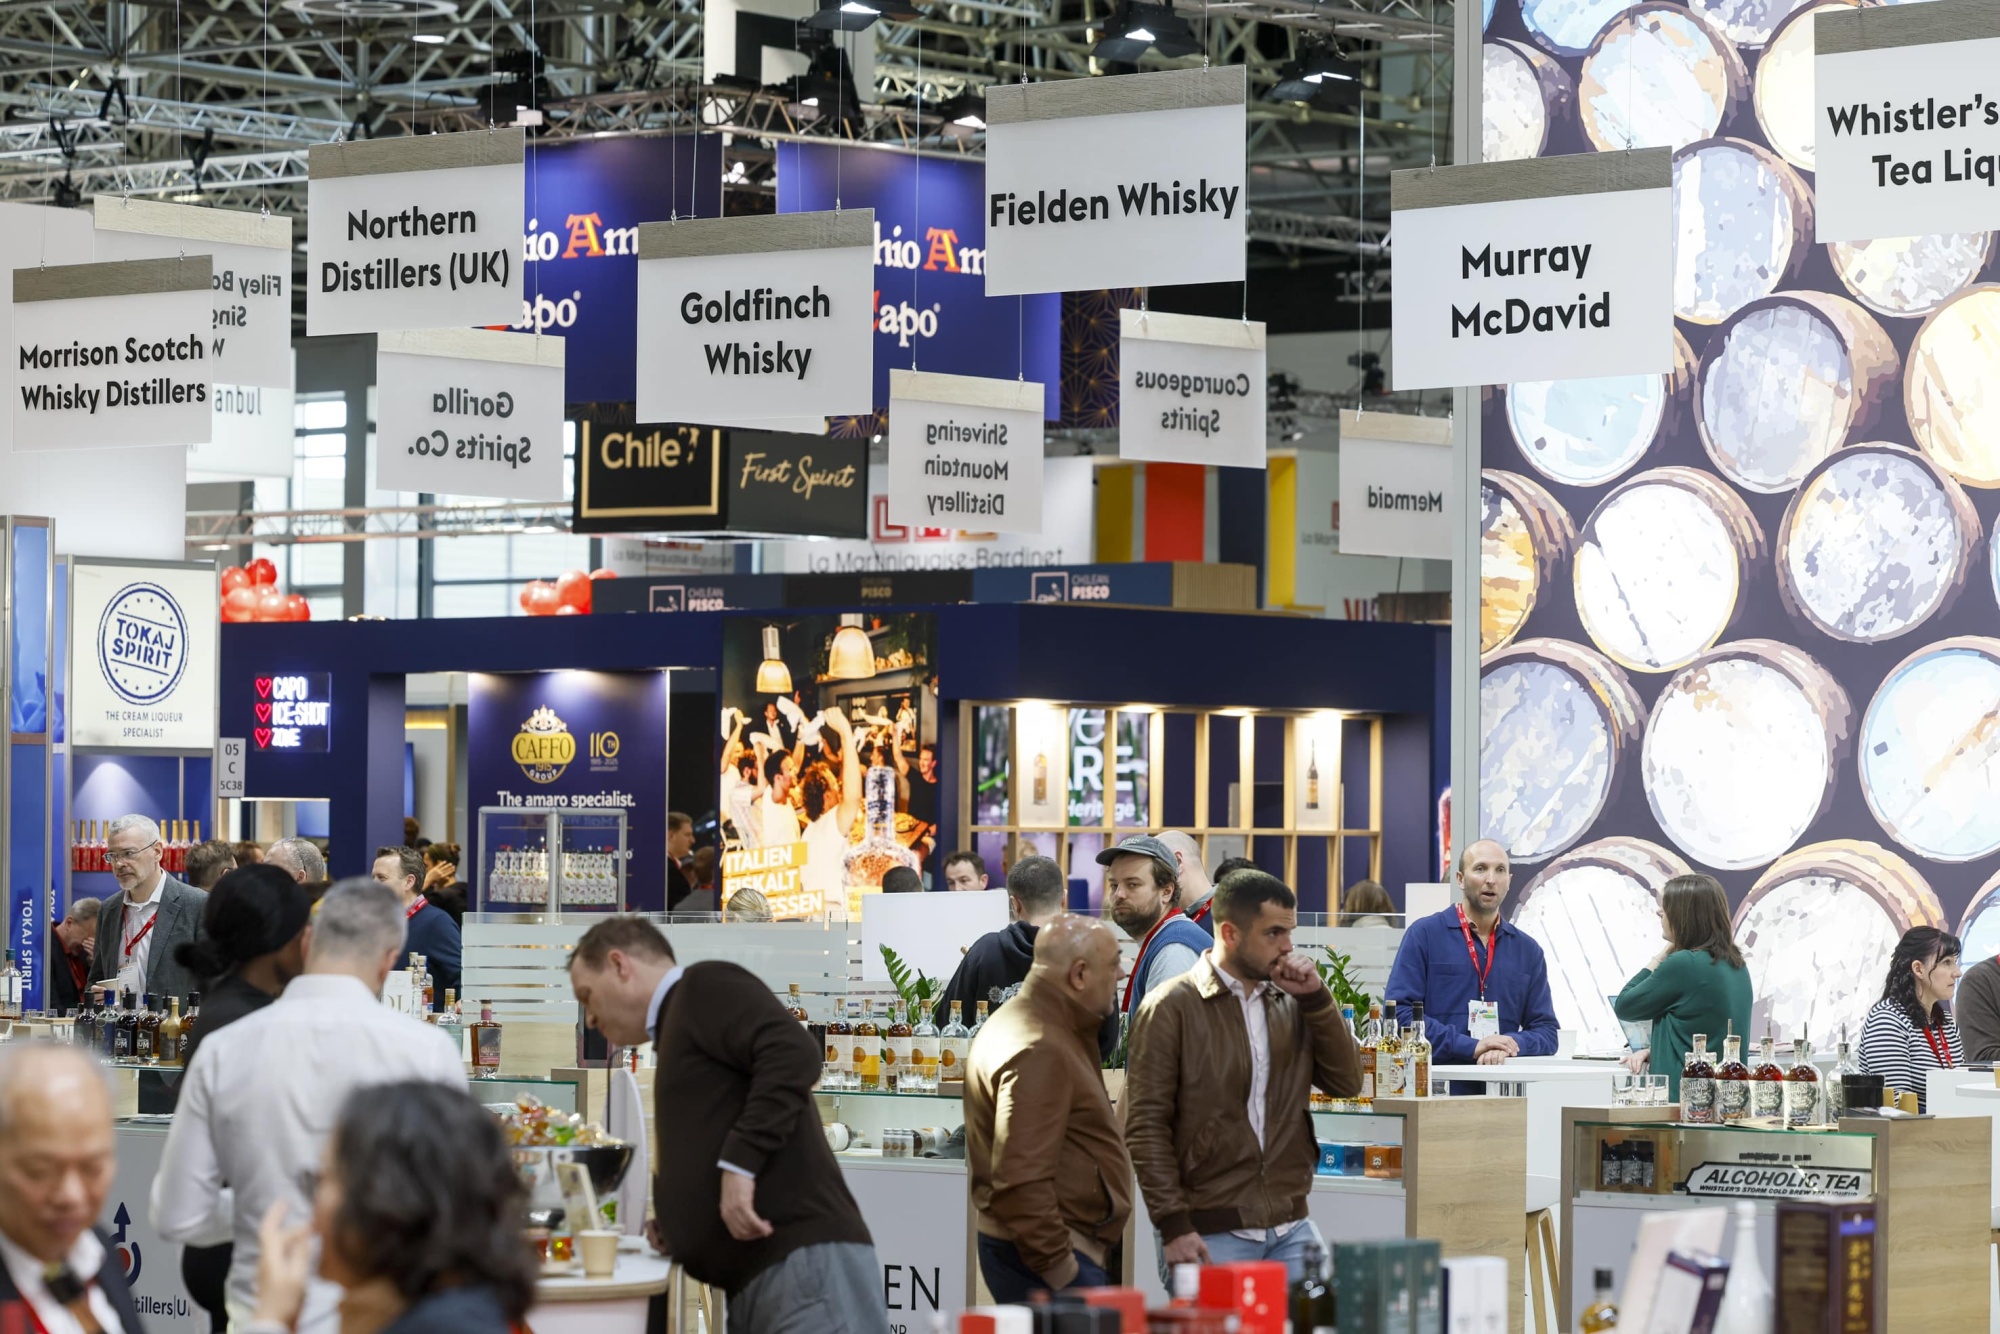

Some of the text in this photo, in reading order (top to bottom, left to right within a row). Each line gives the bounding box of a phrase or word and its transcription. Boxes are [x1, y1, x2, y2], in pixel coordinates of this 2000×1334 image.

[1871, 147, 2000, 187] Tea Liq
[990, 178, 1240, 228] Fielden Whisky
[347, 205, 477, 242] Northern
[321, 248, 510, 293] Distillers (UK)
[1461, 241, 1593, 280] Murray
[680, 284, 831, 325] Goldfinch
[1451, 291, 1610, 339] McDavid
[19, 333, 204, 370] Morrison Scotch
[703, 340, 812, 381] Whisky
[20, 377, 206, 415] Whisky Distillers
[600, 432, 684, 471] Chile
[739, 451, 857, 501] First Spirit
[1072, 585, 1110, 600] PISCO
[116, 618, 175, 650] TOKAJ
[111, 638, 173, 670] SPIRIT
[105, 710, 184, 723] THE CREAM LIQUEUR
[122, 727, 164, 738] SPECIALIST
[225, 744, 240, 756] 05
[515, 736, 572, 761] CAFFO
[220, 780, 243, 791] 5C38
[228, 762, 236, 774] C
[496, 790, 636, 809] The amaro specialist.
[725, 844, 793, 874] ITALIEN
[725, 870, 799, 899] EISKALT
[22, 898, 34, 946] TOKAJ
[21, 948, 34, 992] SPIRIT
[1703, 1168, 1861, 1191] ALCOHOLIC TEA
[1742, 1186, 1768, 1195] STORM
[1768, 1187, 1788, 1195] COLD
[1789, 1188, 1812, 1196] BREW
[883, 1264, 940, 1313] EN
